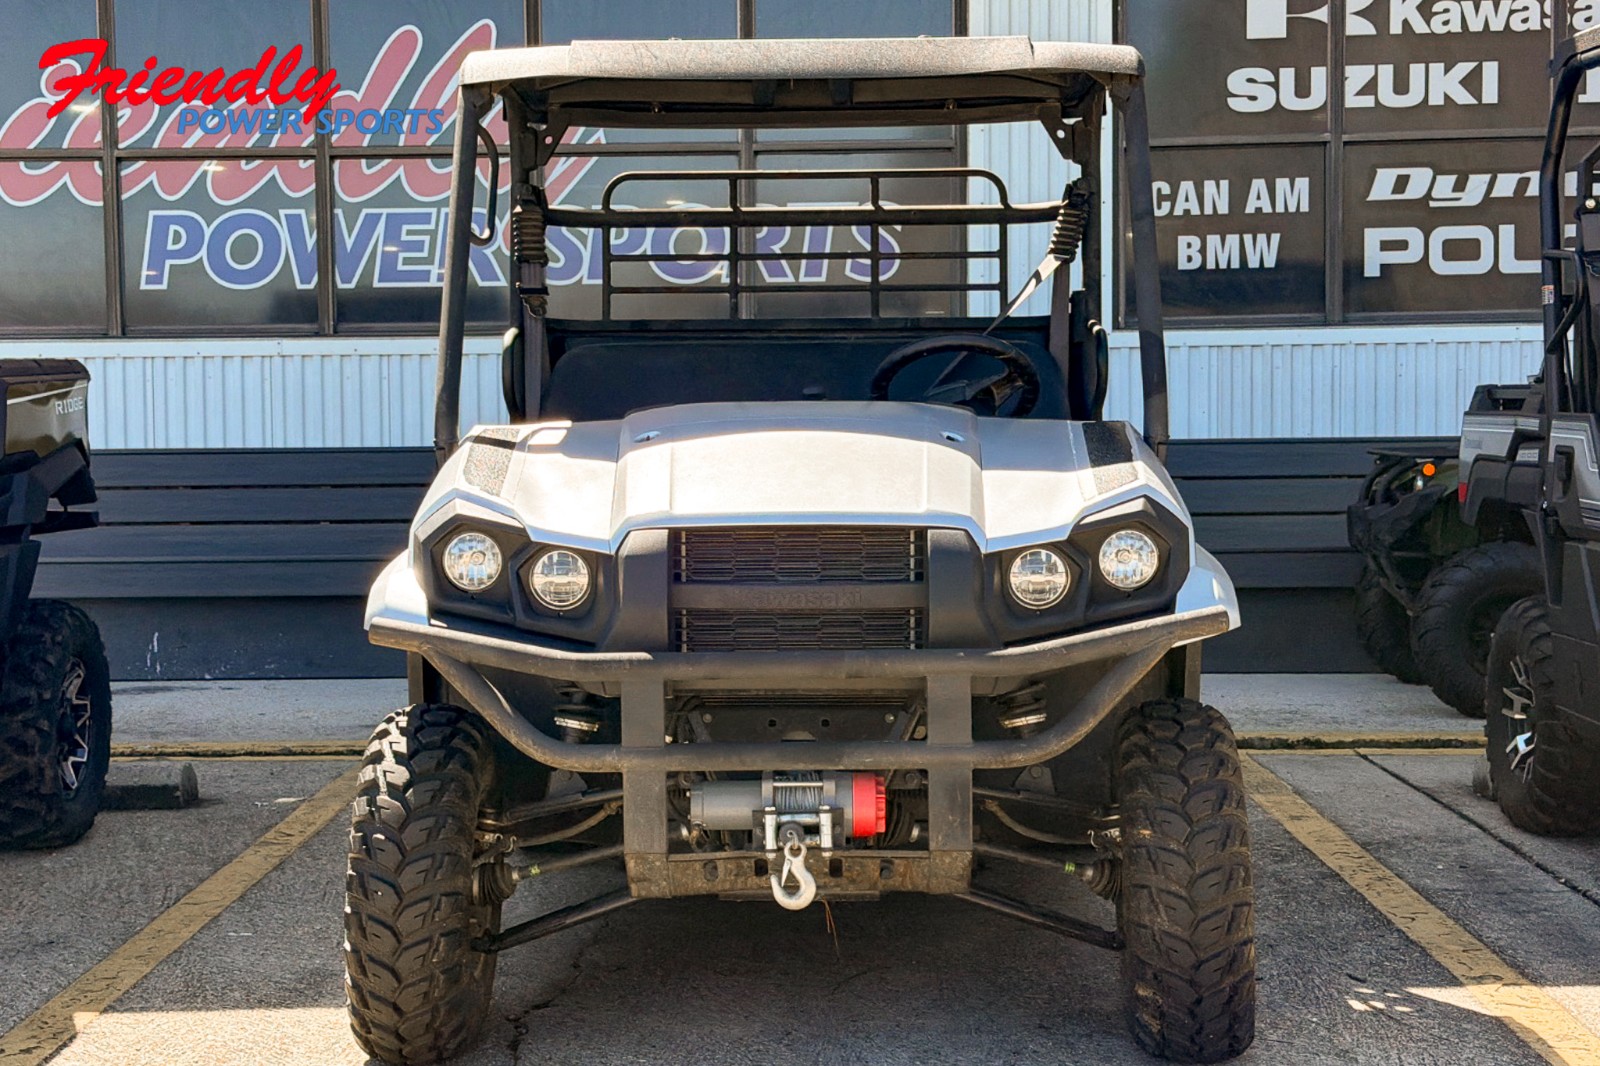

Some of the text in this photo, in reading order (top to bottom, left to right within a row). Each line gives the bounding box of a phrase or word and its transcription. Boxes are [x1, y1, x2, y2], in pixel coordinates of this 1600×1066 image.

[1389, 0, 1600, 35] Kawaa
[1226, 60, 1500, 113] SUZUKI
[1152, 177, 1311, 217] CAN AM
[1177, 232, 1281, 271] BMW
[1363, 223, 1578, 278] POL
[55, 396, 85, 415] RIDGE
